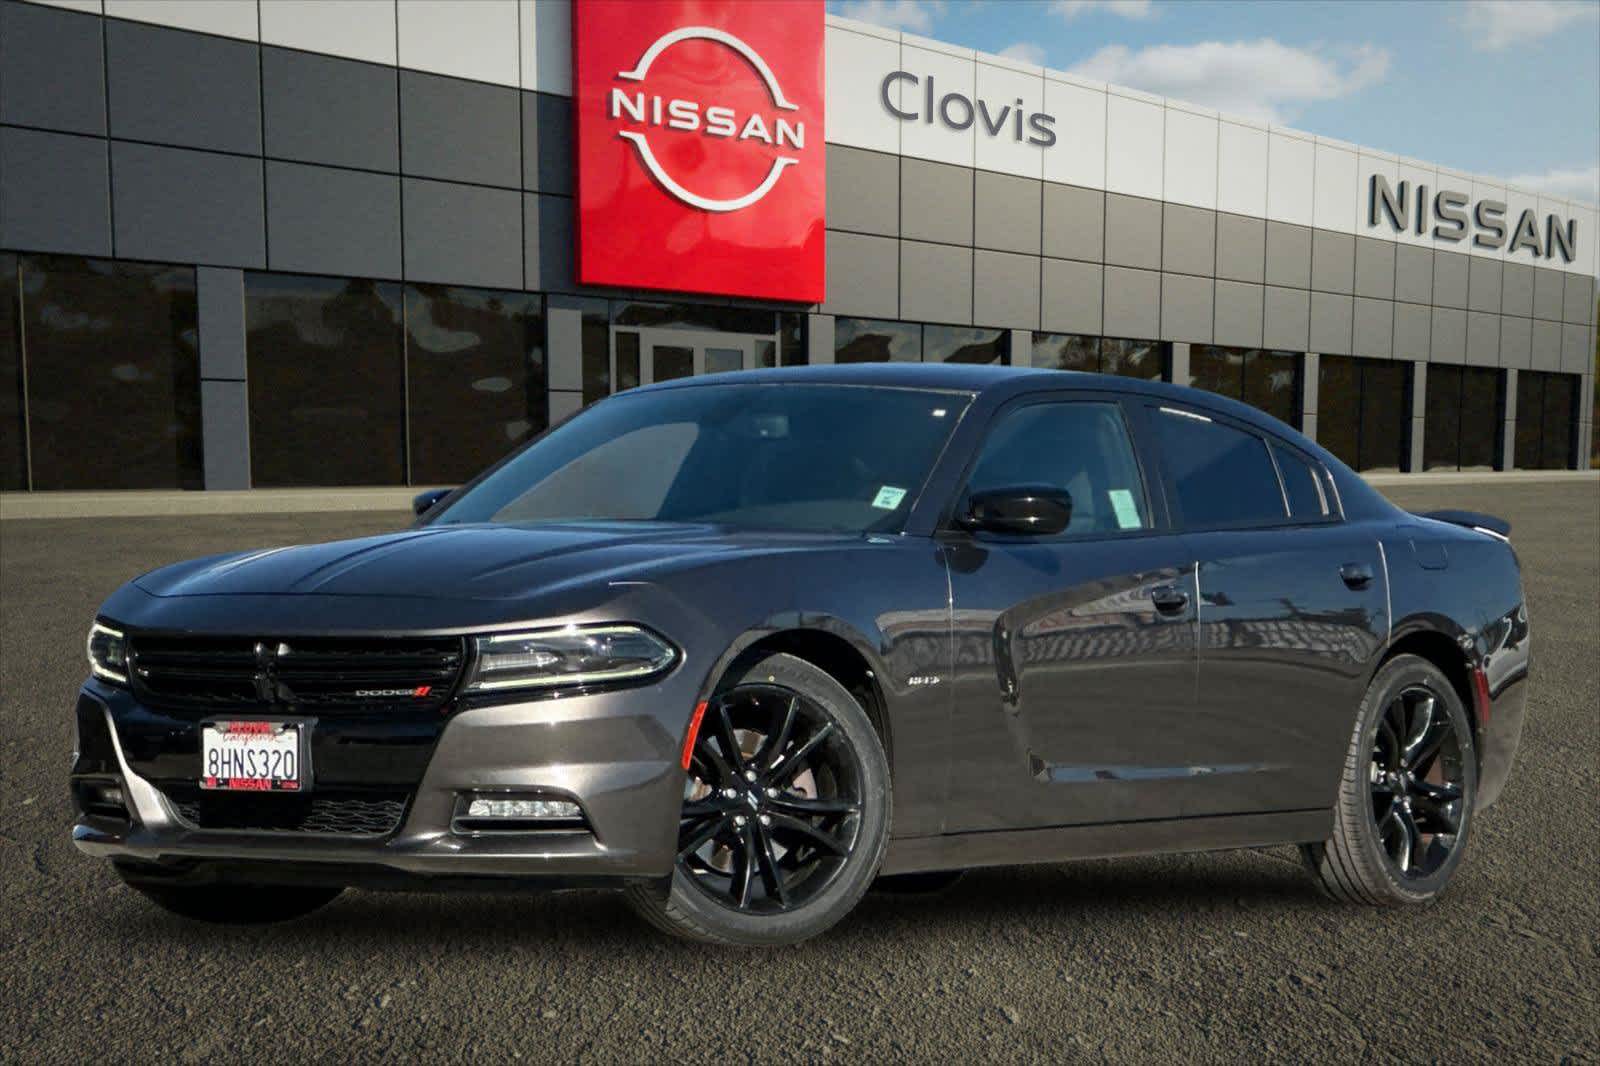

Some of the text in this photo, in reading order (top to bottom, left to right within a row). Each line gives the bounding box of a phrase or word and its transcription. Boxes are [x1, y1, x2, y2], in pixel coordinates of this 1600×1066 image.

[609, 87, 805, 149] NISSAN
[882, 70, 1057, 147] Clovis
[1368, 173, 1578, 264] NISSAN
[208, 748, 295, 779] 8HNS320
[229, 779, 271, 790] NISSAN
